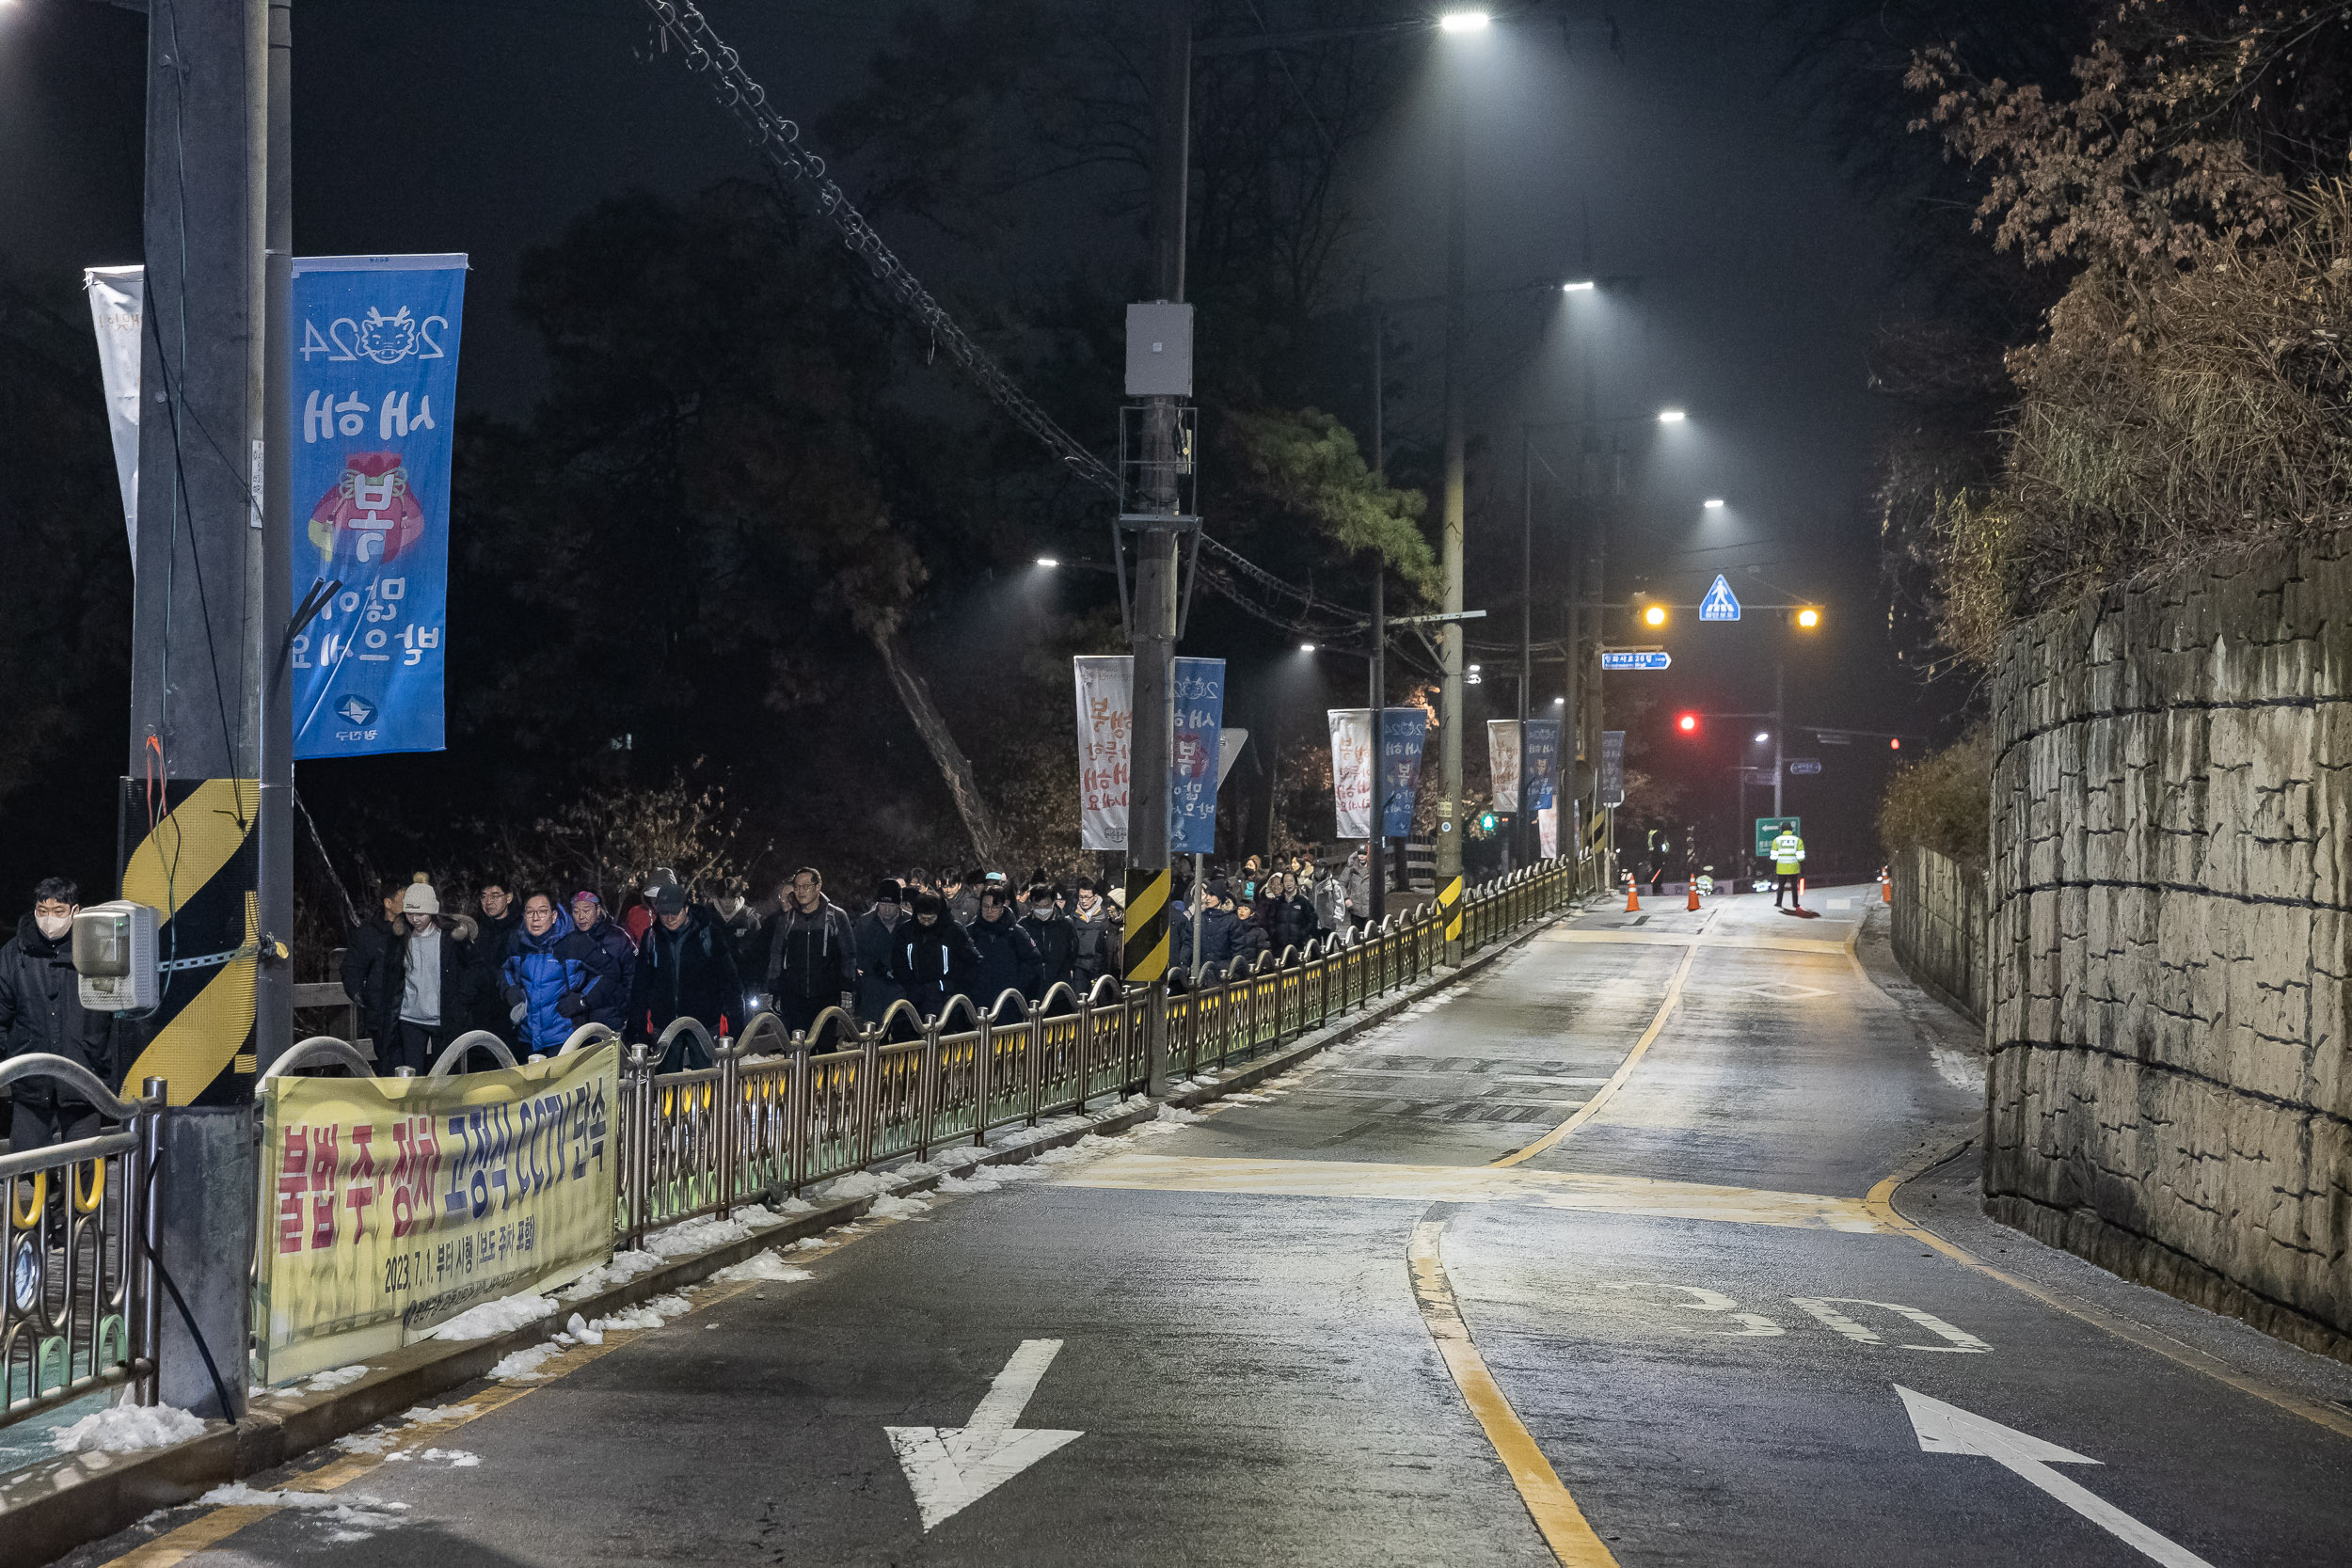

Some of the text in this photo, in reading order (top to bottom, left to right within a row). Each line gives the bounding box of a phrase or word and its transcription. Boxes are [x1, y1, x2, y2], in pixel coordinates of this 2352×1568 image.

[279, 1123, 338, 1253] 불법
[444, 1101, 512, 1219] 고정식
[517, 1093, 570, 1203] CCTV
[573, 1077, 608, 1180] 단속
